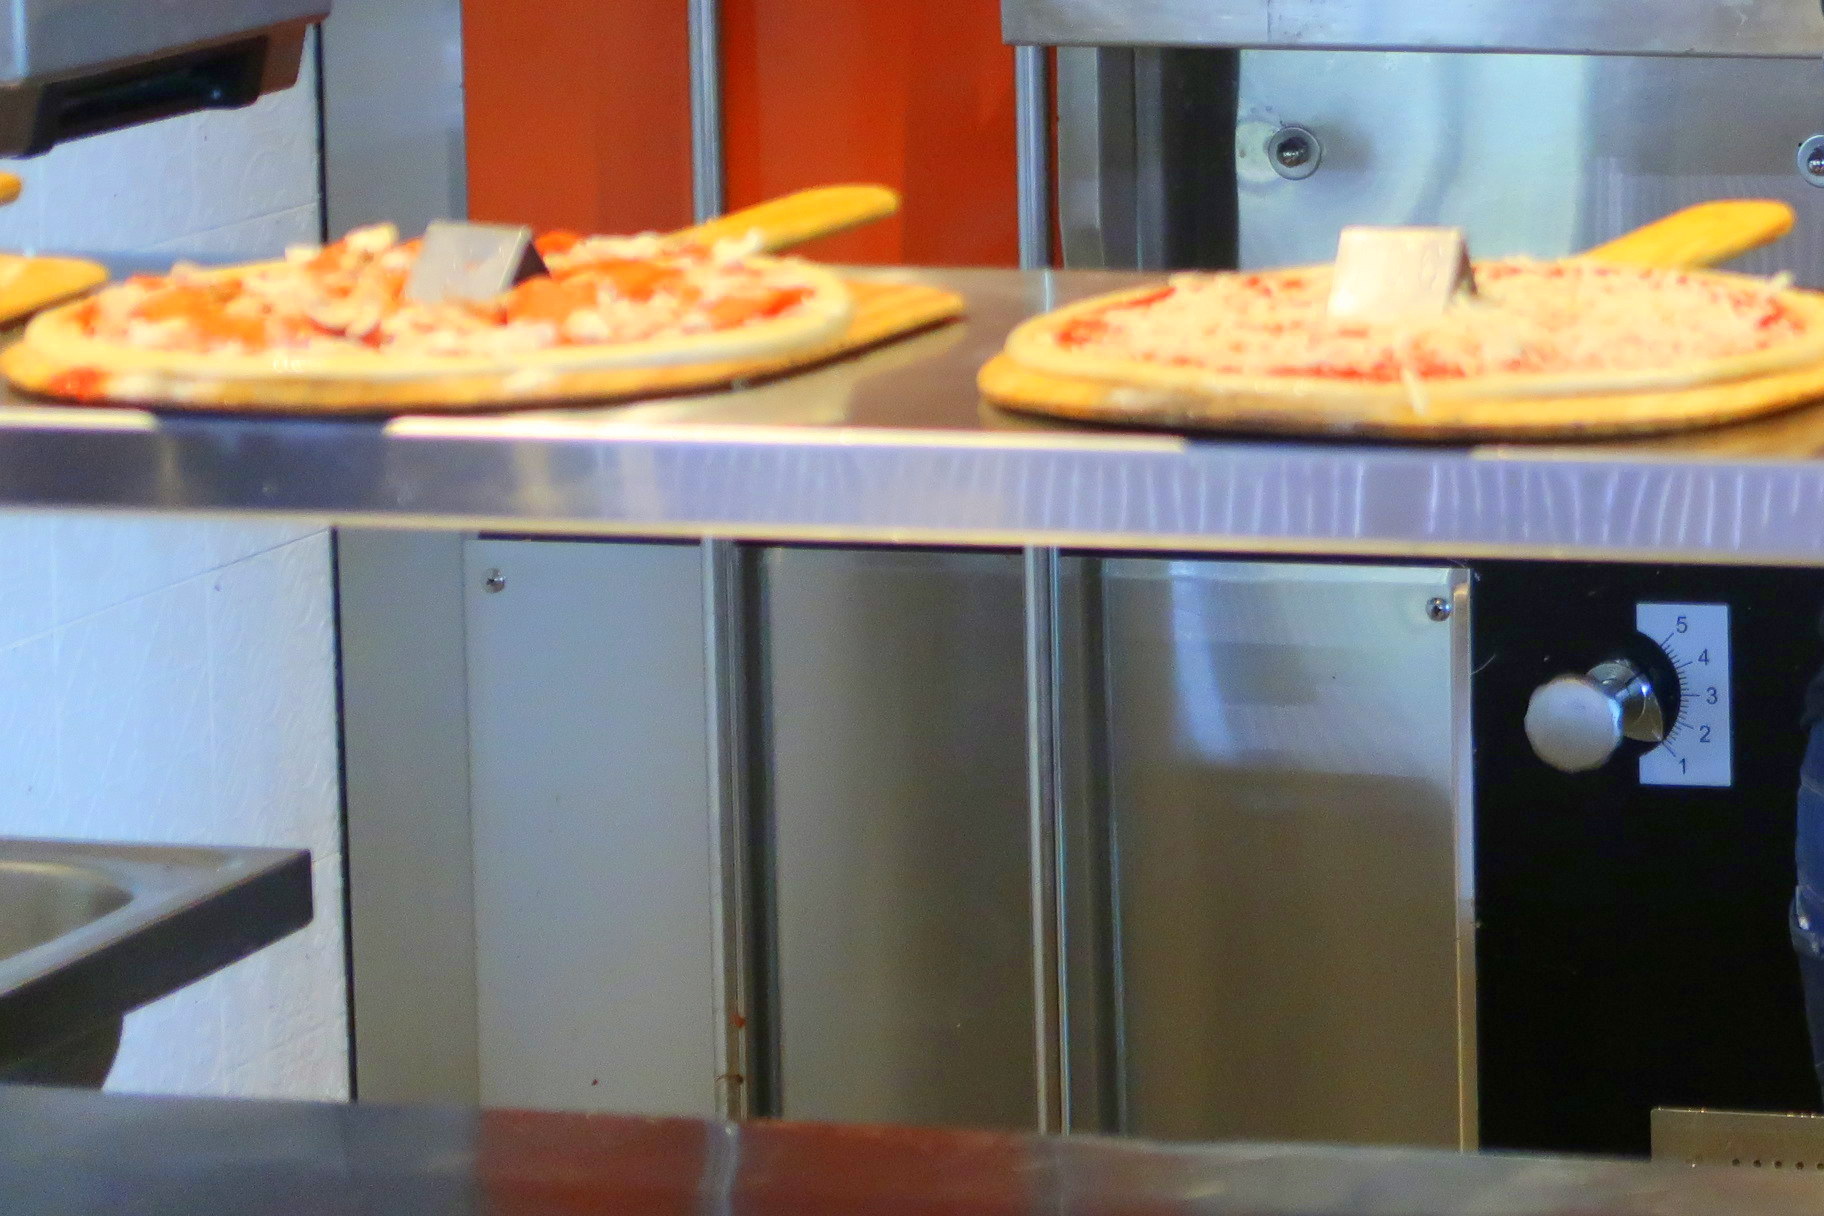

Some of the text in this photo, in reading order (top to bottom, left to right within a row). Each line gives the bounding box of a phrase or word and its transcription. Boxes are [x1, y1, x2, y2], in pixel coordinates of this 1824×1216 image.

[1675, 615, 1689, 634] 5
[1697, 648, 1711, 666] 4
[1705, 686, 1719, 705] 3
[1699, 724, 1712, 744] 2
[1678, 757, 1687, 775] 1
